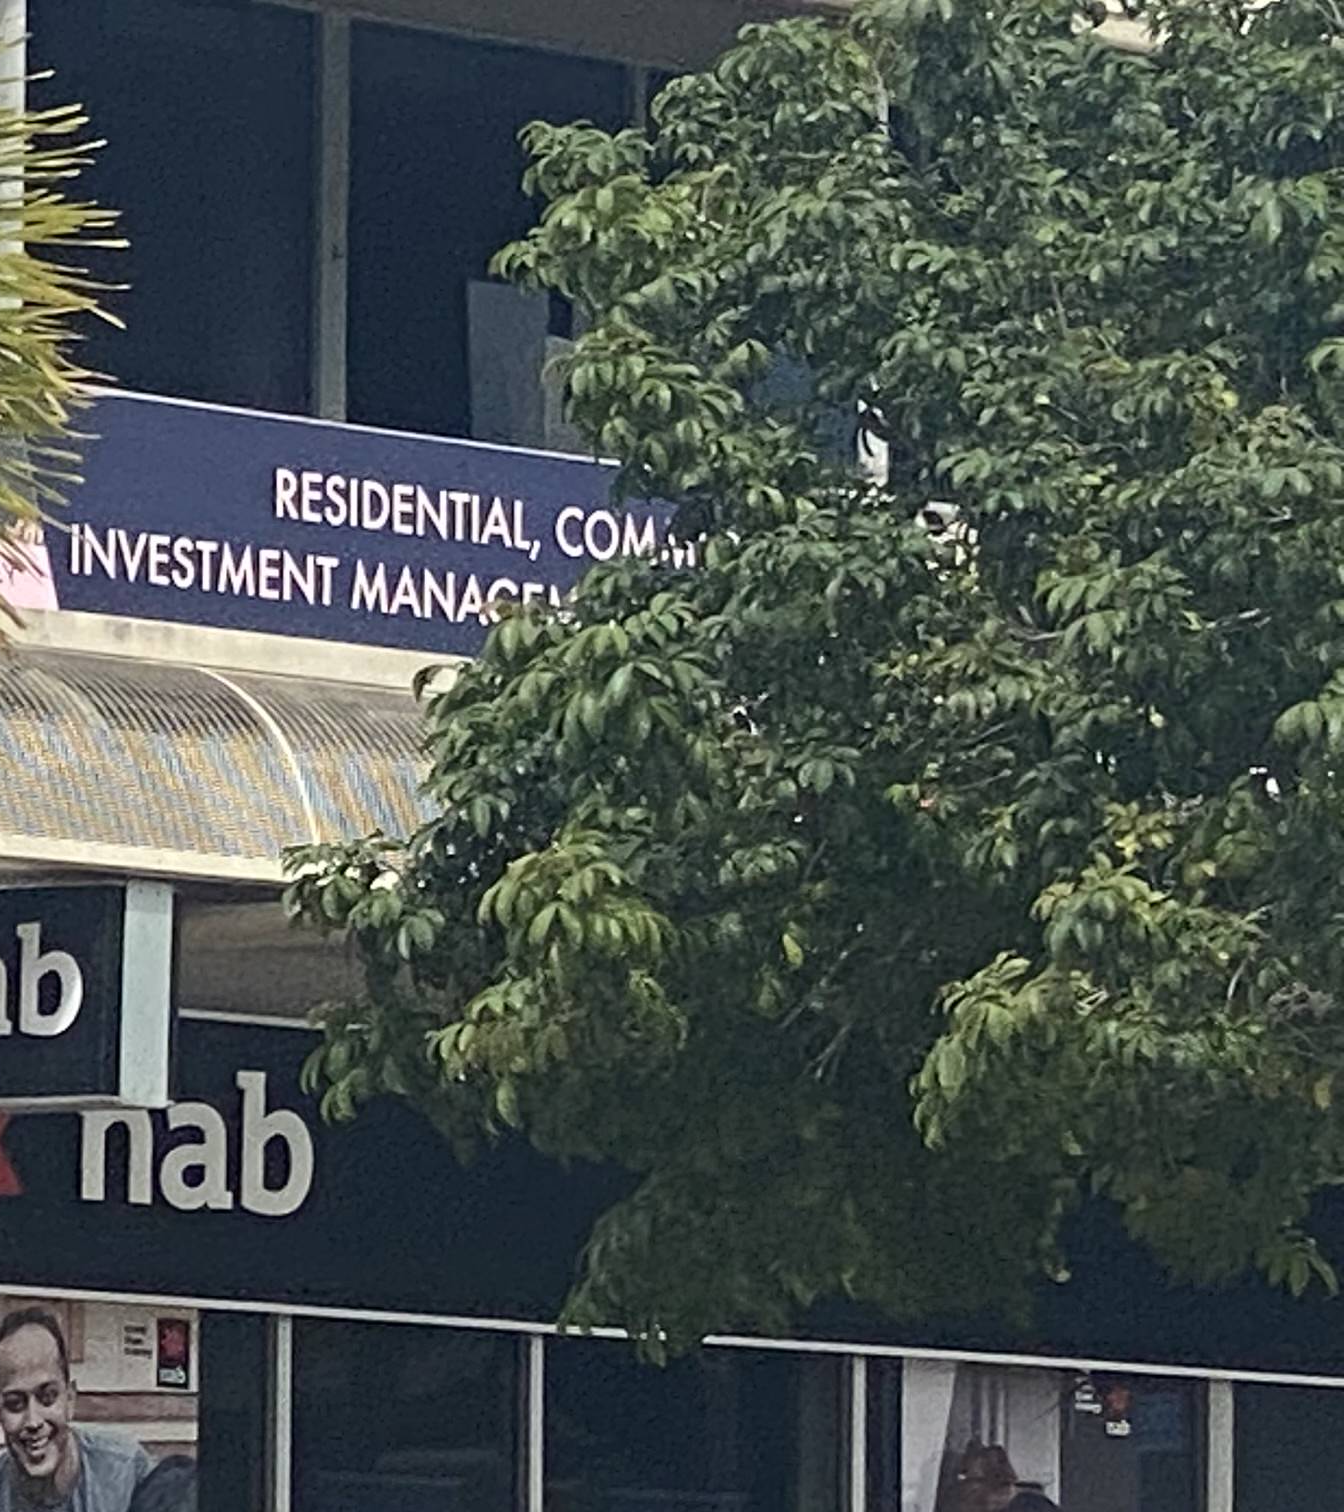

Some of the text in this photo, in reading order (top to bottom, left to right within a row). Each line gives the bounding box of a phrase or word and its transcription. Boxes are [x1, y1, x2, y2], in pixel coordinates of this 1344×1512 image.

[275, 467, 541, 562] RESIDENTIAL,
[70, 523, 338, 607] INVESTMENT
[80, 1070, 315, 1217] nab
